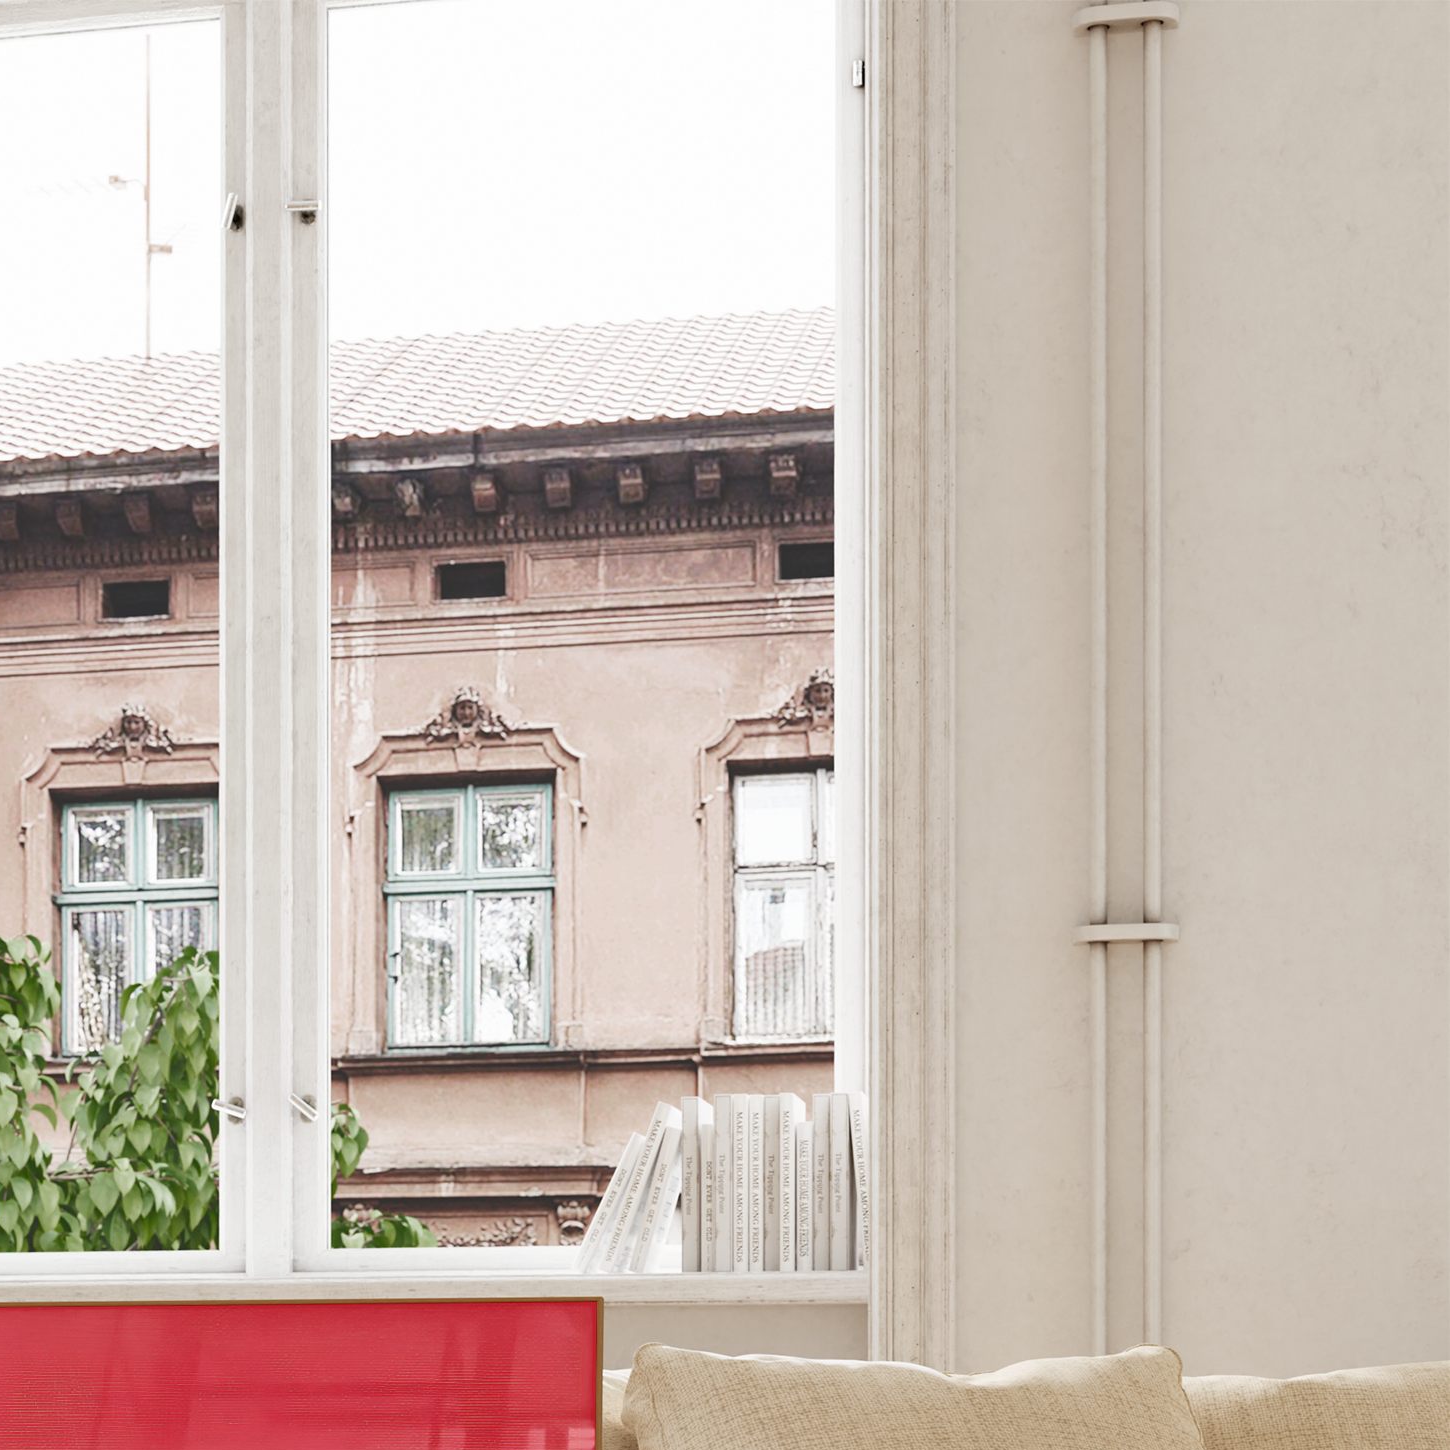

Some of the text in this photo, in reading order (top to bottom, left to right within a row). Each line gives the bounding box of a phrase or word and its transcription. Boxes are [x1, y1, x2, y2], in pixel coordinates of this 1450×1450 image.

[855, 1135, 864, 1160] YOUR
[858, 1162, 867, 1188] HOME
[605, 1120, 662, 1261] MAKE YOUR HOME AMONG FRIENDS
[860, 1190, 869, 1224] AMONG
